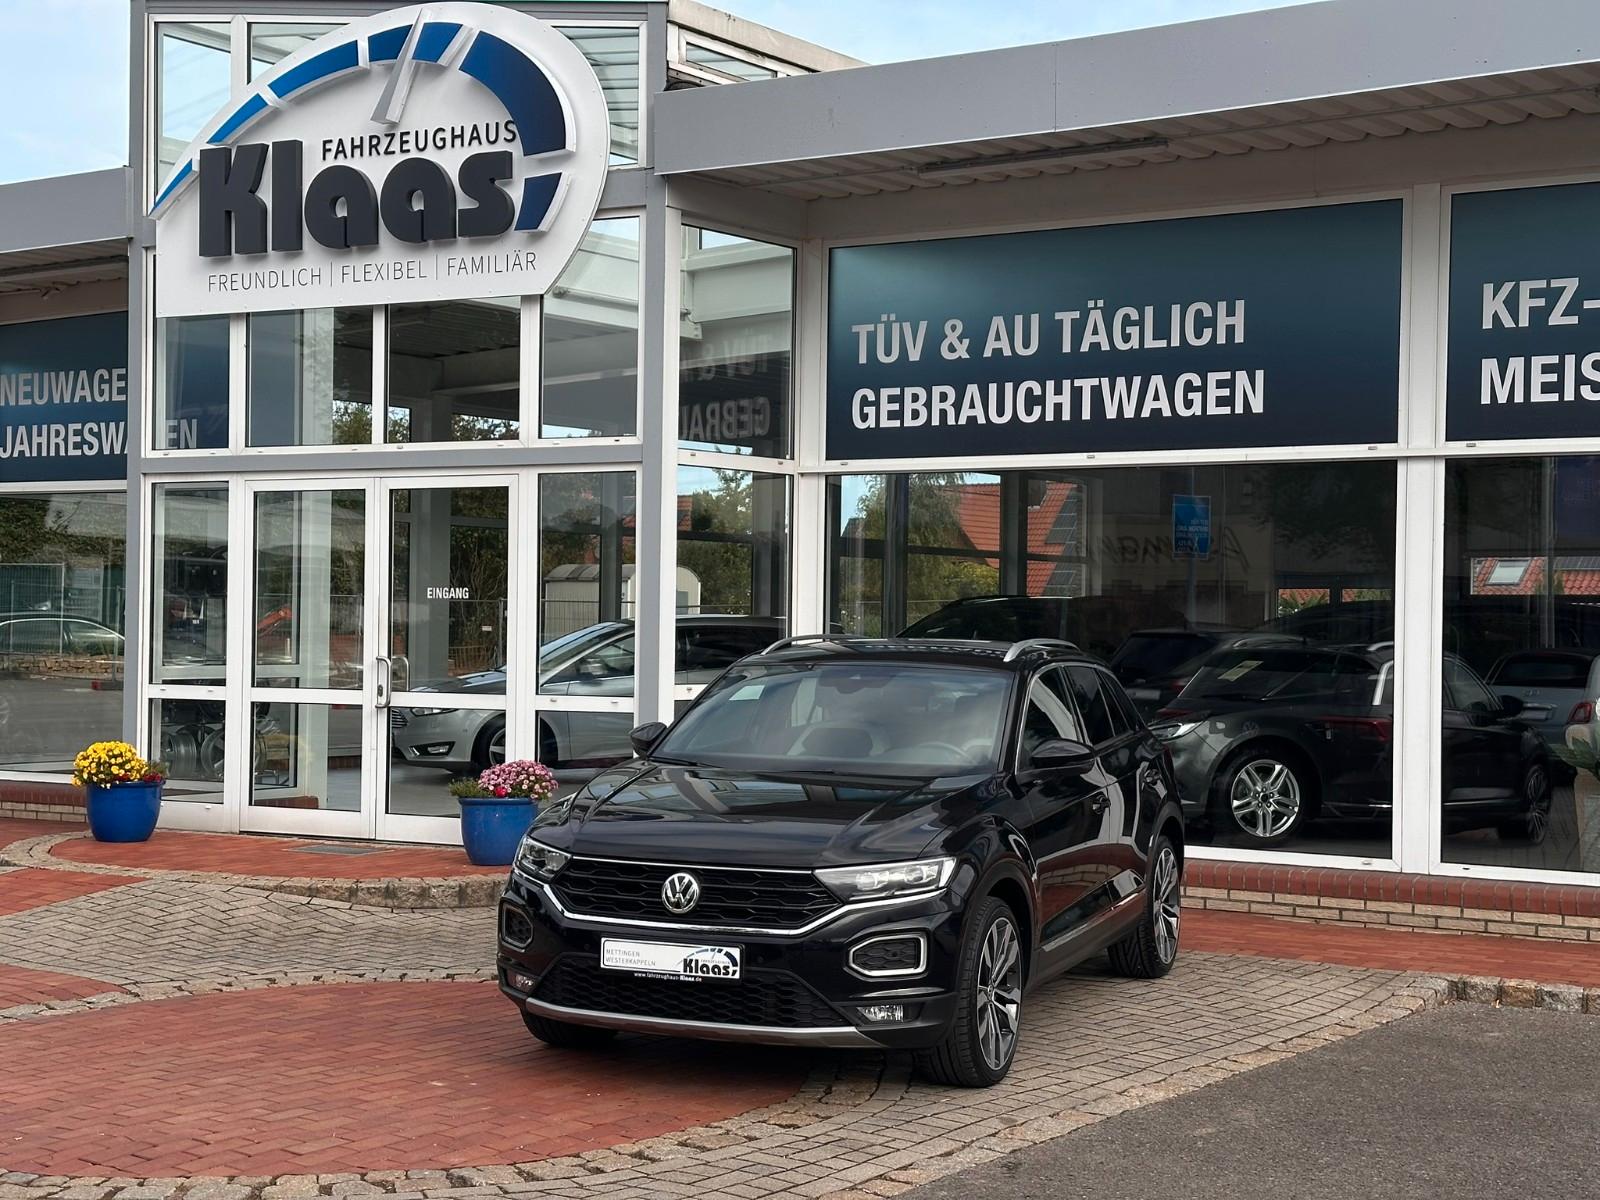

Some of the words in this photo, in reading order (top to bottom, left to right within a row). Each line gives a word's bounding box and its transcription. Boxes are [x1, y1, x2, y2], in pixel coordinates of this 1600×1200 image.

[322, 119, 517, 161] FAHRZEUGHAUS
[199, 139, 515, 258] Klaas
[208, 262, 322, 292] FREUNDLICH
[341, 259, 427, 284] FLEXIBEL
[447, 249, 537, 276] FAMILIÄR
[1482, 277, 1600, 330] KFZ-
[851, 314, 928, 365] TÜV
[940, 318, 970, 361] &
[983, 313, 1041, 358] AU
[1055, 299, 1246, 353] TÄGLICH
[852, 370, 1265, 430] GEBRAUCHTWAGEN
[1480, 352, 1600, 405] MEIS
[427, 587, 469, 599] EINGANG
[683, 958, 731, 976] Klaas
